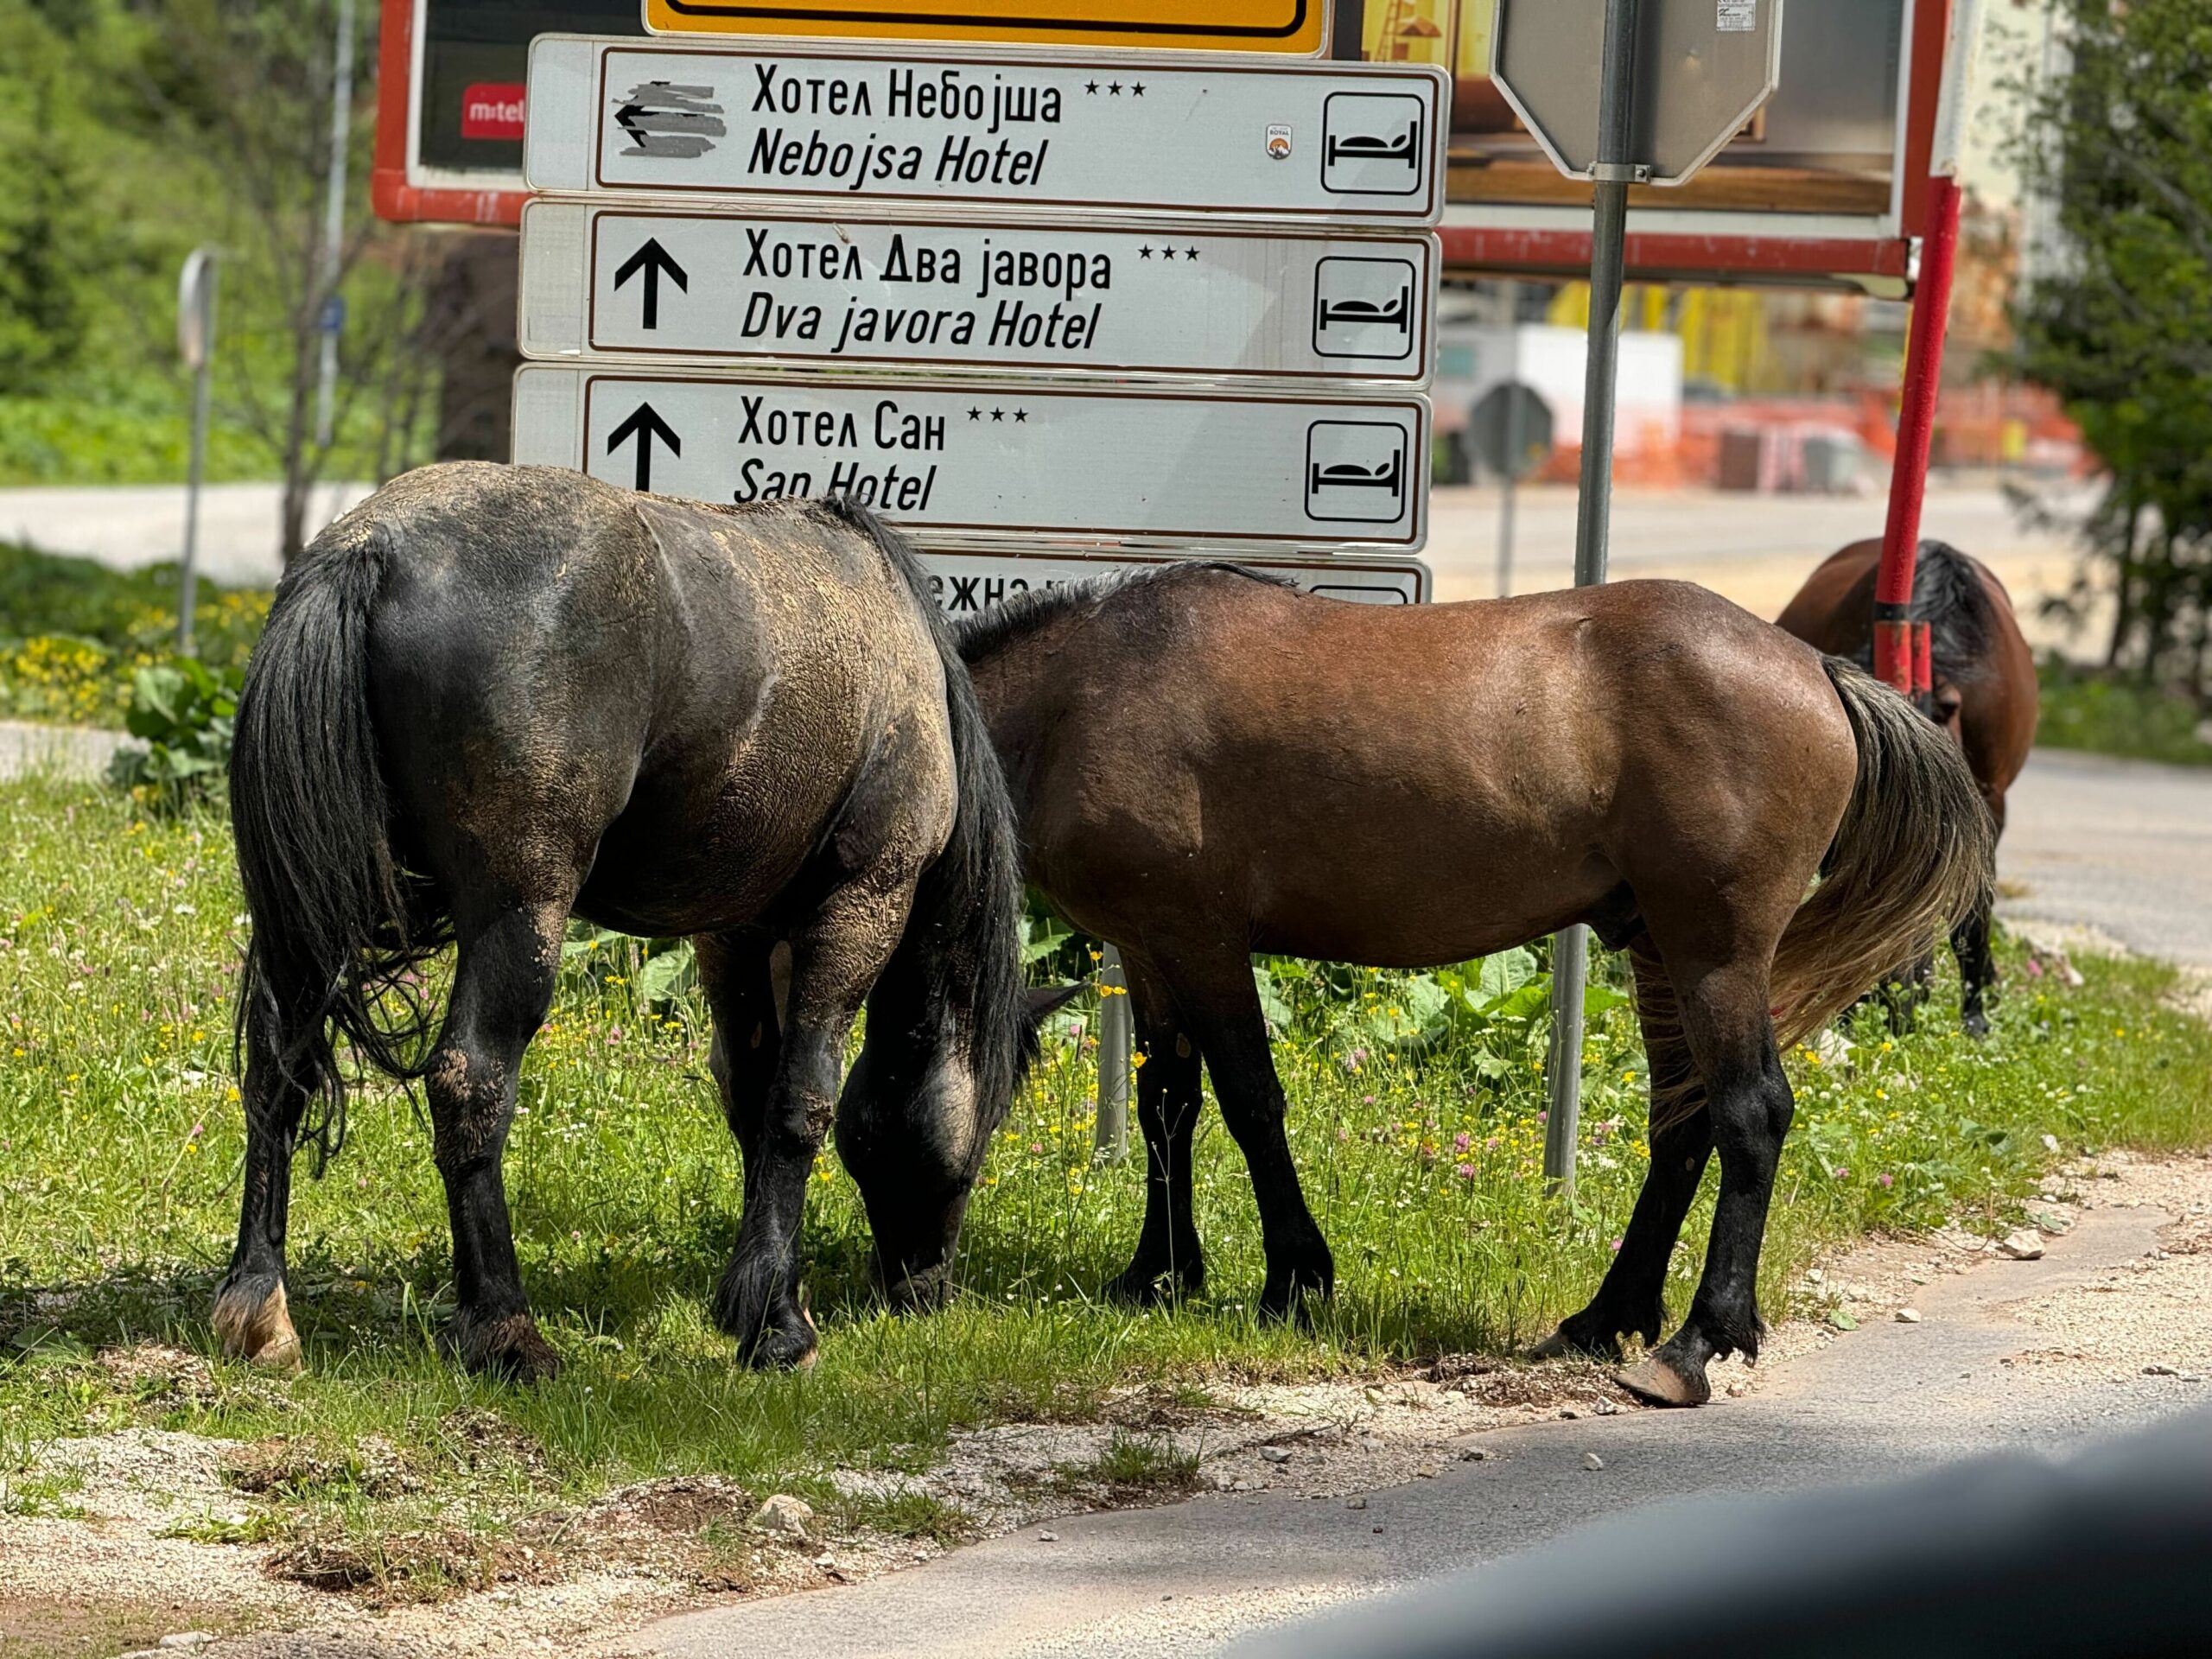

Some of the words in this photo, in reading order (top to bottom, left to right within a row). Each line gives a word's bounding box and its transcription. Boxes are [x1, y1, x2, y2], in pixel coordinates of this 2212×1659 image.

[752, 64, 871, 116] Хотел
[888, 67, 1062, 133] Небојша
[747, 128, 922, 190] Nebojsa
[935, 136, 1048, 185] Hotel
[743, 229, 861, 280] Хотел
[880, 234, 960, 283] Два
[977, 238, 1110, 301] јавора
[741, 292, 821, 339] Dva
[830, 296, 975, 353] javora
[988, 300, 1102, 348] Hotel
[738, 396, 858, 448] Хотел
[874, 400, 945, 451] Сан
[734, 458, 811, 503] San
[827, 461, 938, 511] Hotel
